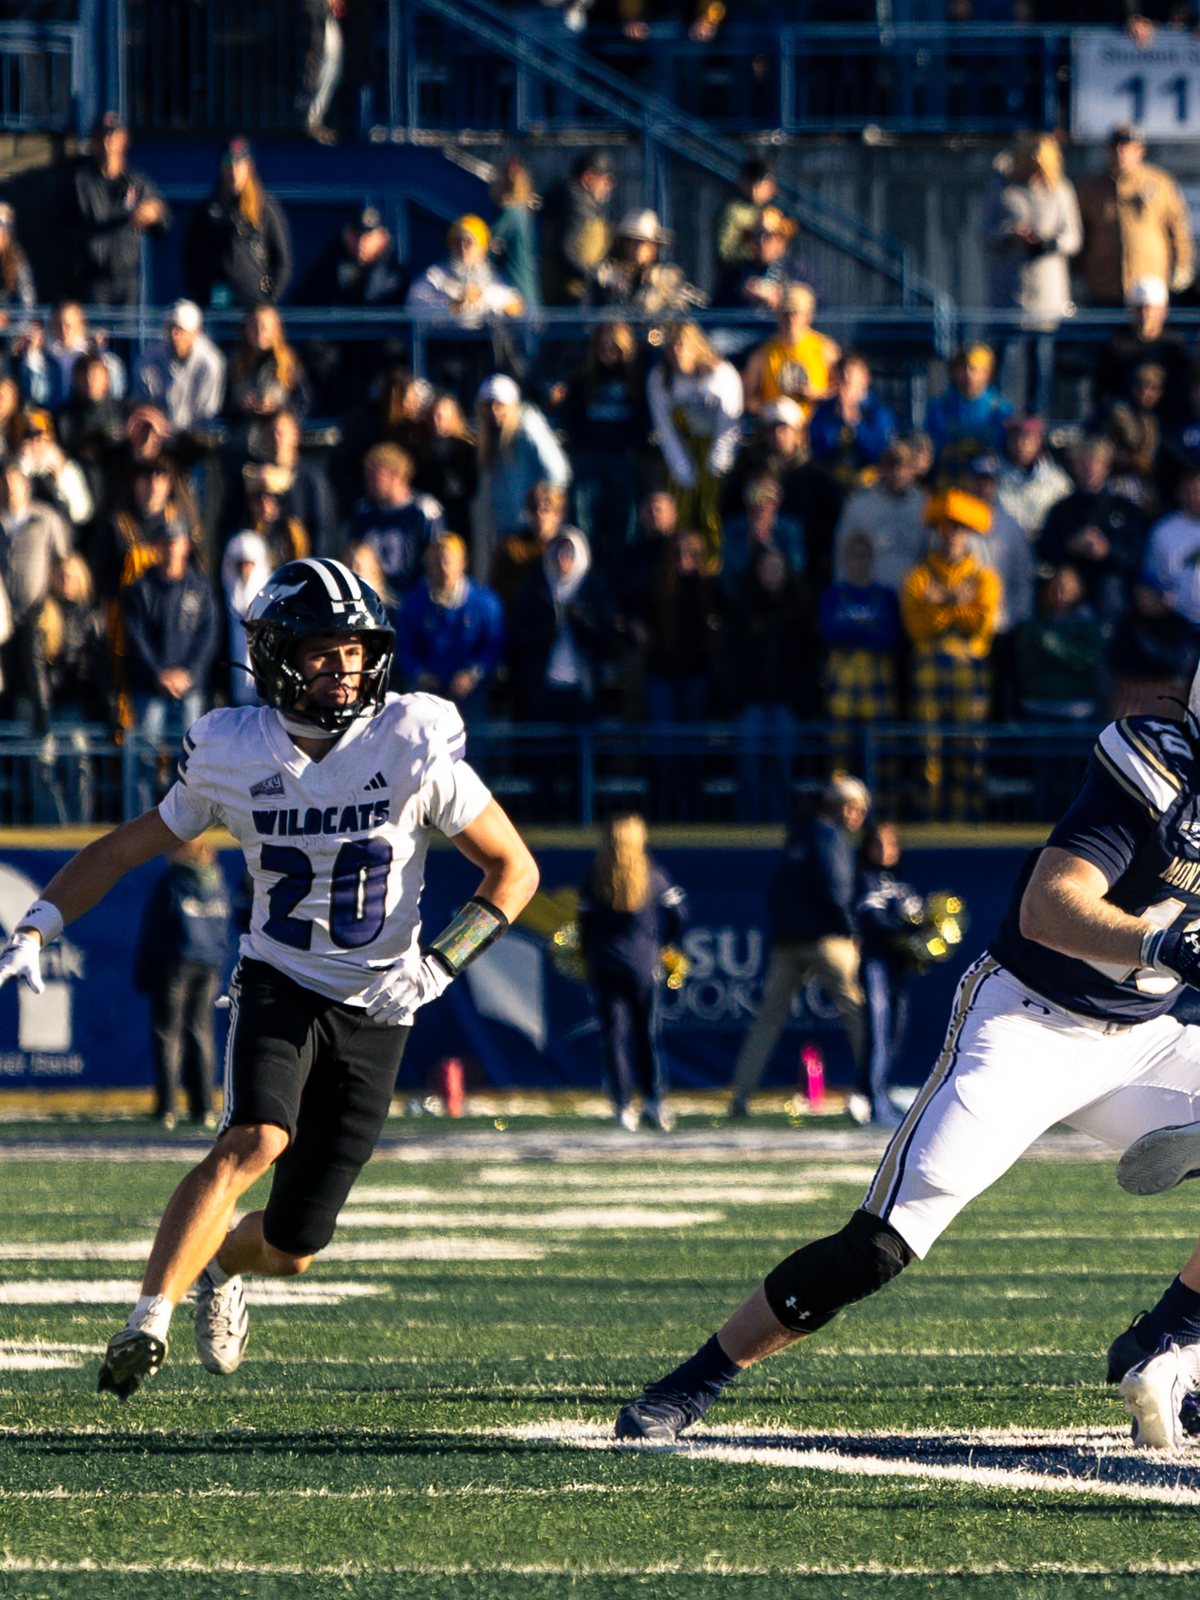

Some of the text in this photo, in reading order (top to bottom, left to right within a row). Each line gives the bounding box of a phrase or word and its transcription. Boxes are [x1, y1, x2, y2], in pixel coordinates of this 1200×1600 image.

[252, 800, 390, 836] WILDCATS
[260, 836, 393, 951] 20
[683, 925, 763, 978] SU
